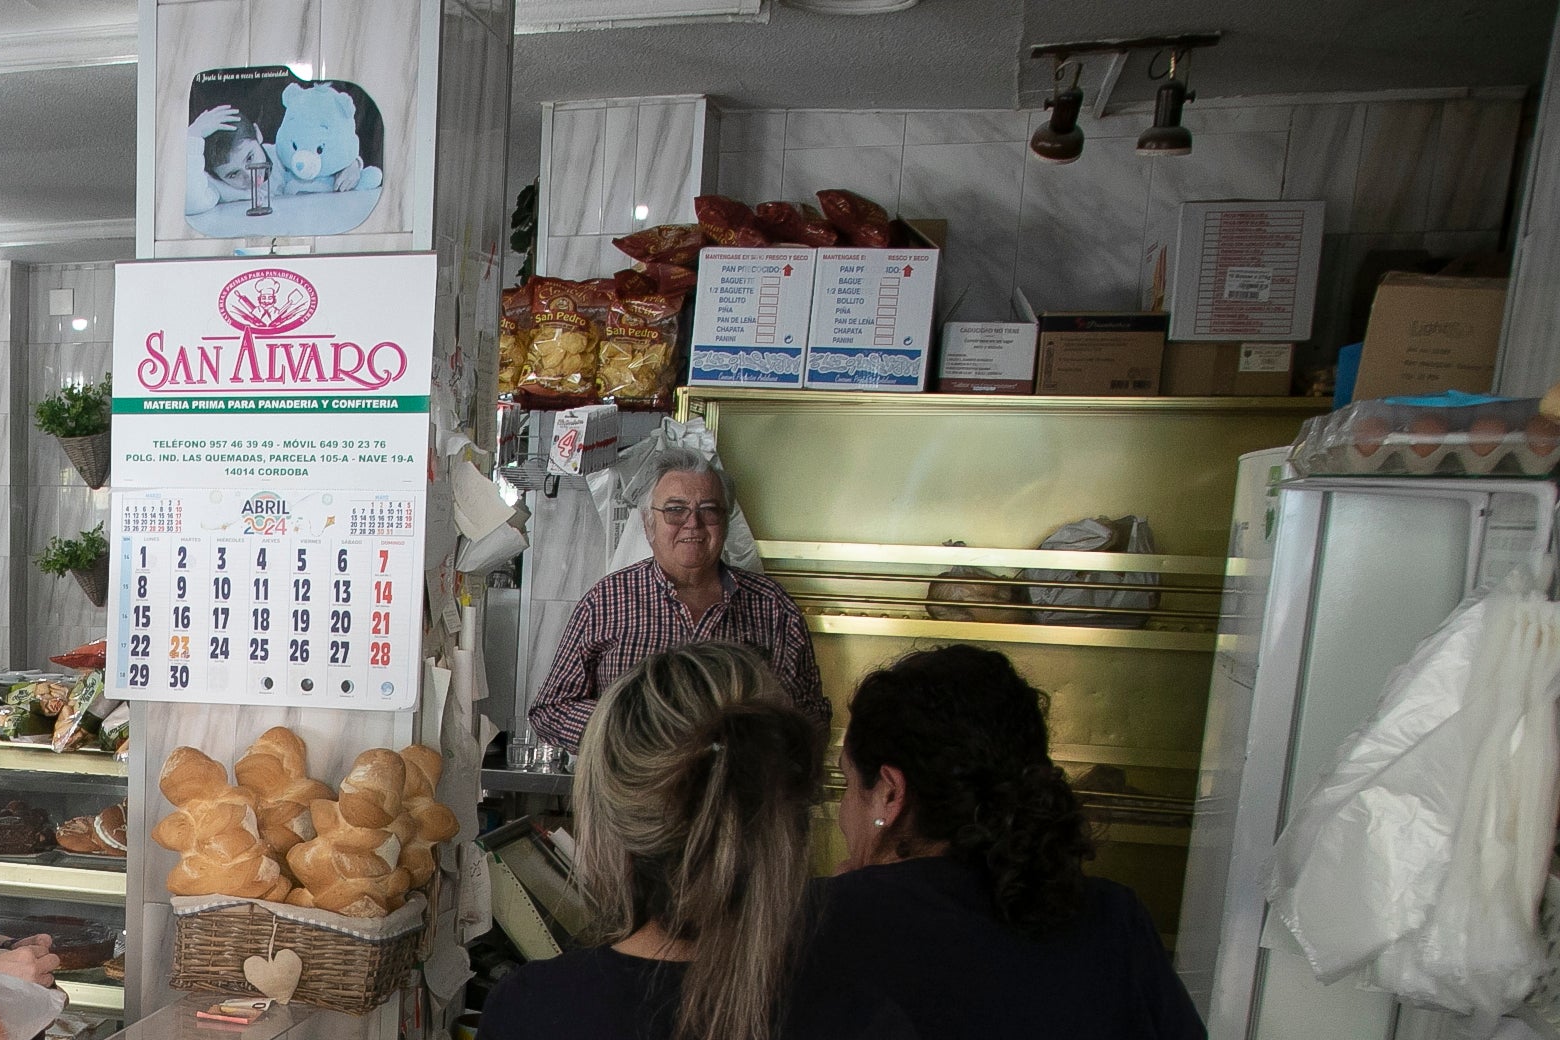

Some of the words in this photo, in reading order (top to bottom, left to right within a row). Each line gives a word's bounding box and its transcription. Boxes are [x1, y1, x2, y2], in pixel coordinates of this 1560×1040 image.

[227, 275, 248, 291] PRIMAS
[266, 271, 300, 282] PANADERIA
[718, 305, 733, 313] PIÑA
[835, 306, 851, 314] PIÑA
[535, 311, 553, 323] San
[556, 311, 586, 326] Pedro
[740, 315, 756, 323] LEÑA
[858, 317, 874, 325] LEÑA
[606, 326, 625, 336] San
[628, 326, 659, 339] Pedro
[137, 329, 222, 390] SAN
[230, 325, 408, 388] ALVARO
[144, 401, 189, 409] MATERIA
[192, 400, 225, 409] PRIMA
[228, 400, 255, 409] PARA
[258, 400, 318, 408] PANADERIA
[321, 400, 329, 408] Y
[332, 400, 398, 408] CONFITERIA
[153, 439, 206, 448] TELÉFONO
[283, 439, 316, 448] MÓVIL
[558, 429, 578, 458] 4
[126, 454, 155, 462] POLG.
[205, 454, 266, 463] QUEMADAS,
[258, 468, 309, 476] CORDOBA
[241, 500, 289, 515] ABRIL
[243, 517, 287, 535] 2024
[140, 546, 147, 568] 1
[178, 546, 187, 568] 2
[217, 547, 226, 570] 3
[256, 548, 267, 570] 4
[297, 548, 307, 571] 5
[338, 549, 348, 572] 6
[379, 550, 389, 573] 7
[138, 576, 148, 598] 8
[177, 576, 187, 599] 9
[213, 577, 231, 600] 10
[254, 578, 269, 601] 11
[294, 579, 311, 602] 12
[334, 580, 351, 603] 13
[375, 581, 392, 604] 14
[134, 605, 150, 628] 15
[173, 606, 190, 629] 16
[213, 607, 230, 629] 17
[252, 608, 270, 631] 18
[293, 609, 310, 632] 19
[331, 610, 351, 633] 20
[372, 611, 390, 635] 21
[131, 635, 150, 657] 22
[170, 635, 190, 658] 23
[210, 637, 230, 659] 24
[250, 638, 269, 661] 25
[290, 639, 310, 663] 26
[330, 641, 350, 663] 27
[370, 642, 390, 665] 28
[129, 664, 150, 686] 29
[170, 665, 189, 688] 30
